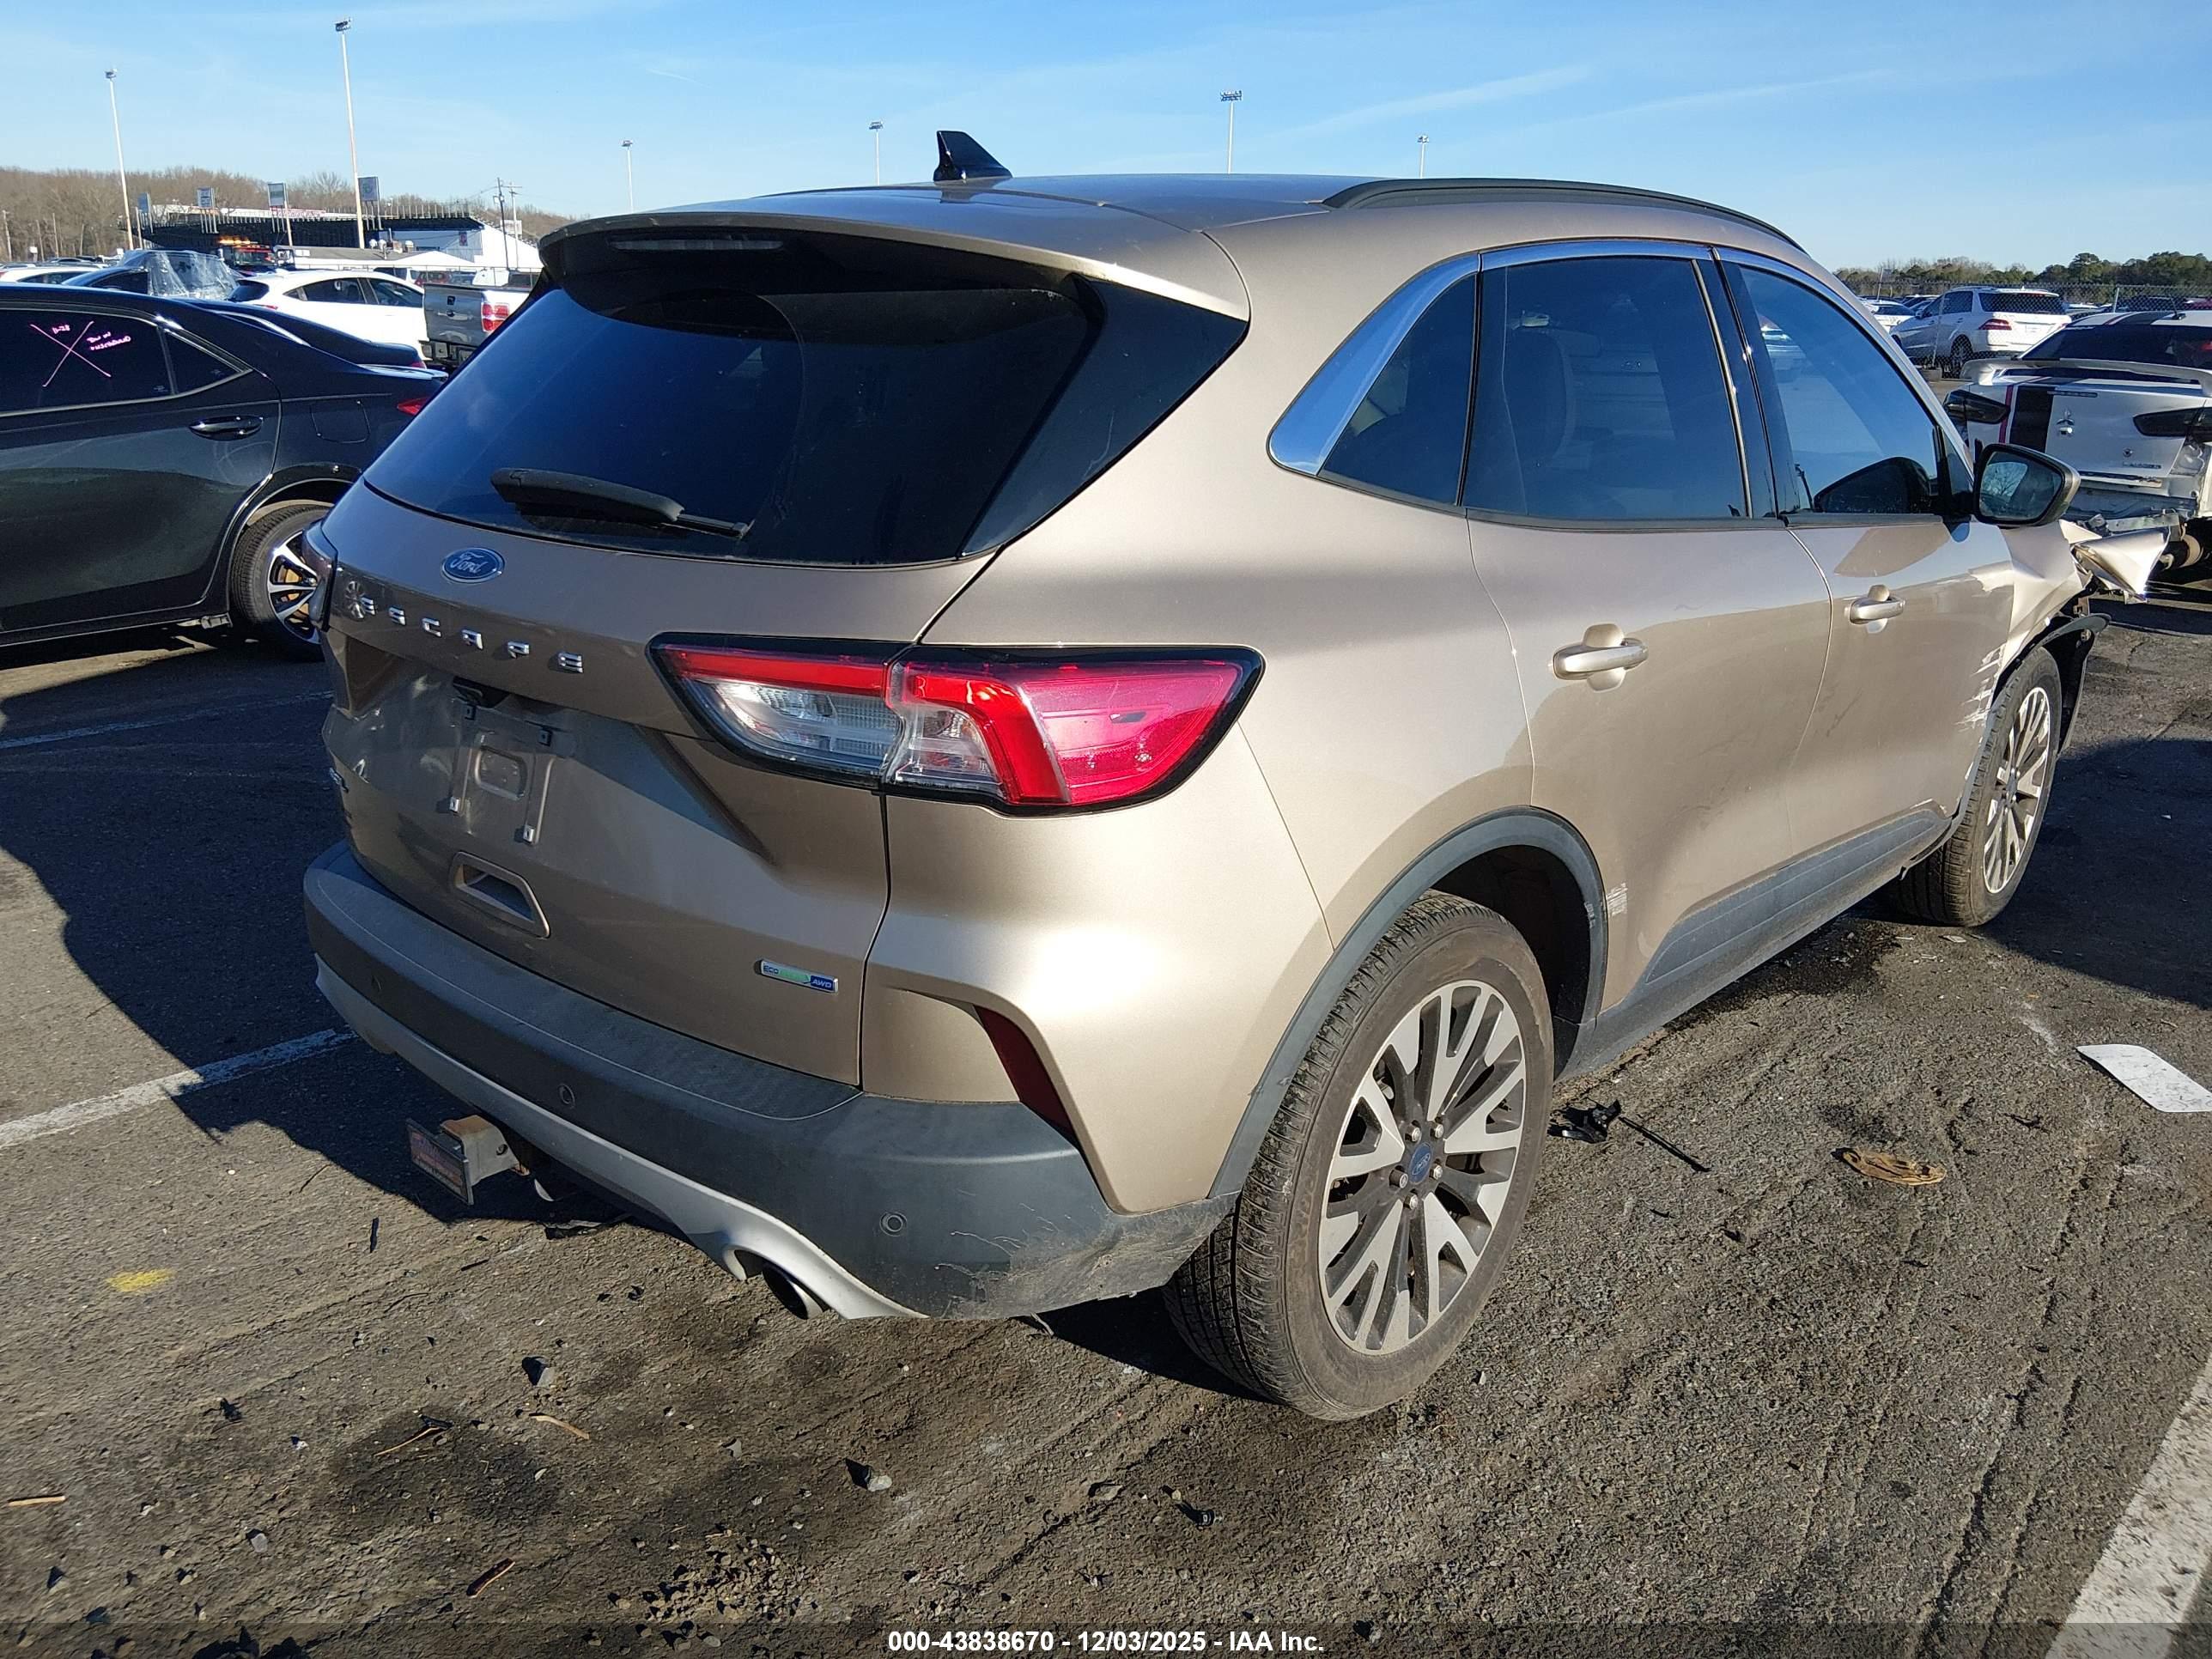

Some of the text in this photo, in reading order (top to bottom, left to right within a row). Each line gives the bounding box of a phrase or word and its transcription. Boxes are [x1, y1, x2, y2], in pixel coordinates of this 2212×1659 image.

[450, 551, 489, 574] Ford
[361, 596, 584, 673] ESCAPE
[811, 978, 833, 989] AWD
